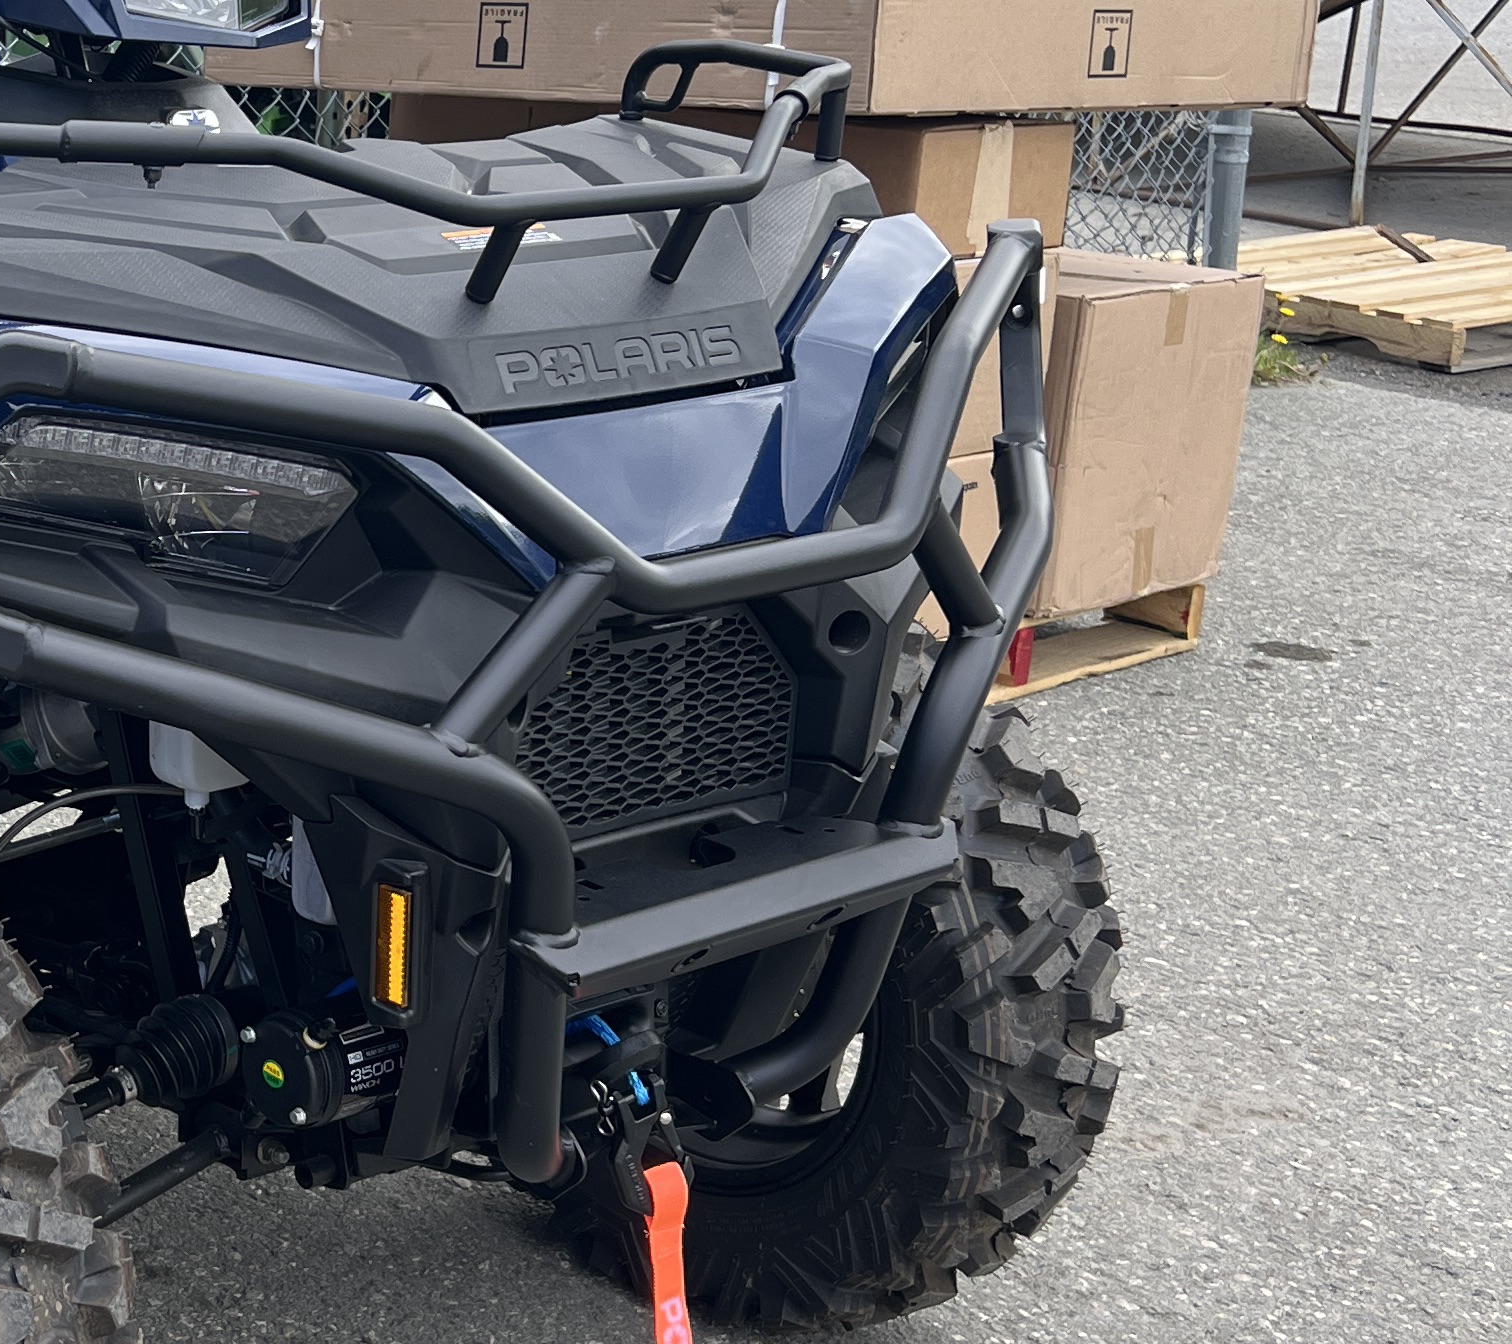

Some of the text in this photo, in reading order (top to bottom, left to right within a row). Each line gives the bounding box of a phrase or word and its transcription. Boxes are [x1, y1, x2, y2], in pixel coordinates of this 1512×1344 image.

[484, 8, 524, 17] FRAGILE
[1096, 15, 1129, 25] FRAGILE
[495, 325, 741, 394] POLARIS
[350, 1058, 395, 1083] 3500
